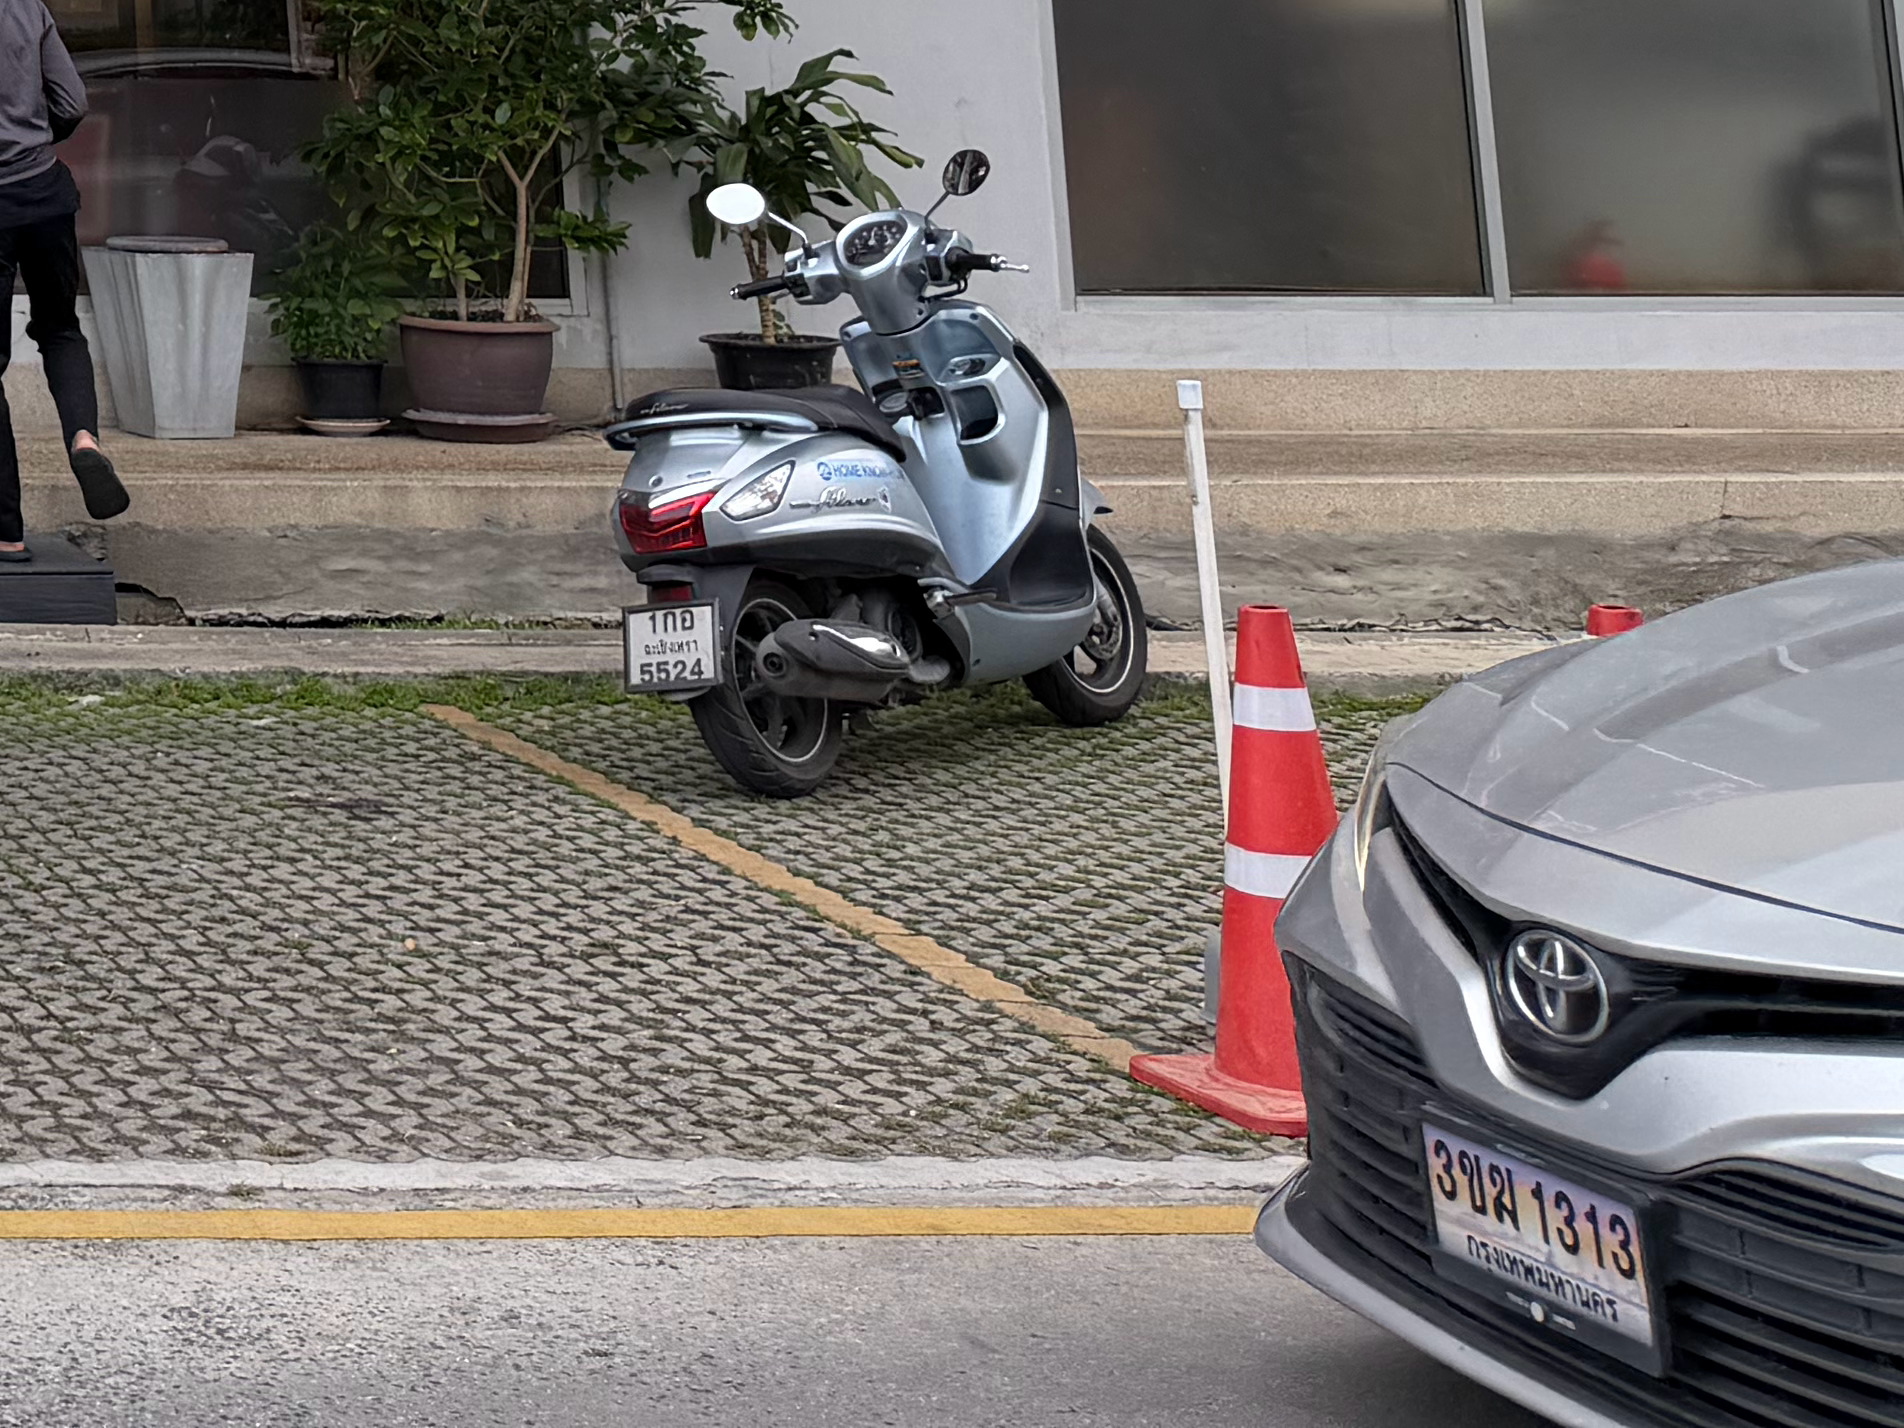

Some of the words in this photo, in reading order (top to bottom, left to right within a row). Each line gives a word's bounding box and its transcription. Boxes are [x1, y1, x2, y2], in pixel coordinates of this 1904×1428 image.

[639, 658, 704, 683] 5524
[1530, 1180, 1636, 1280] 1313
[1467, 1234, 1620, 1323] กรุงเทพมหานคร
